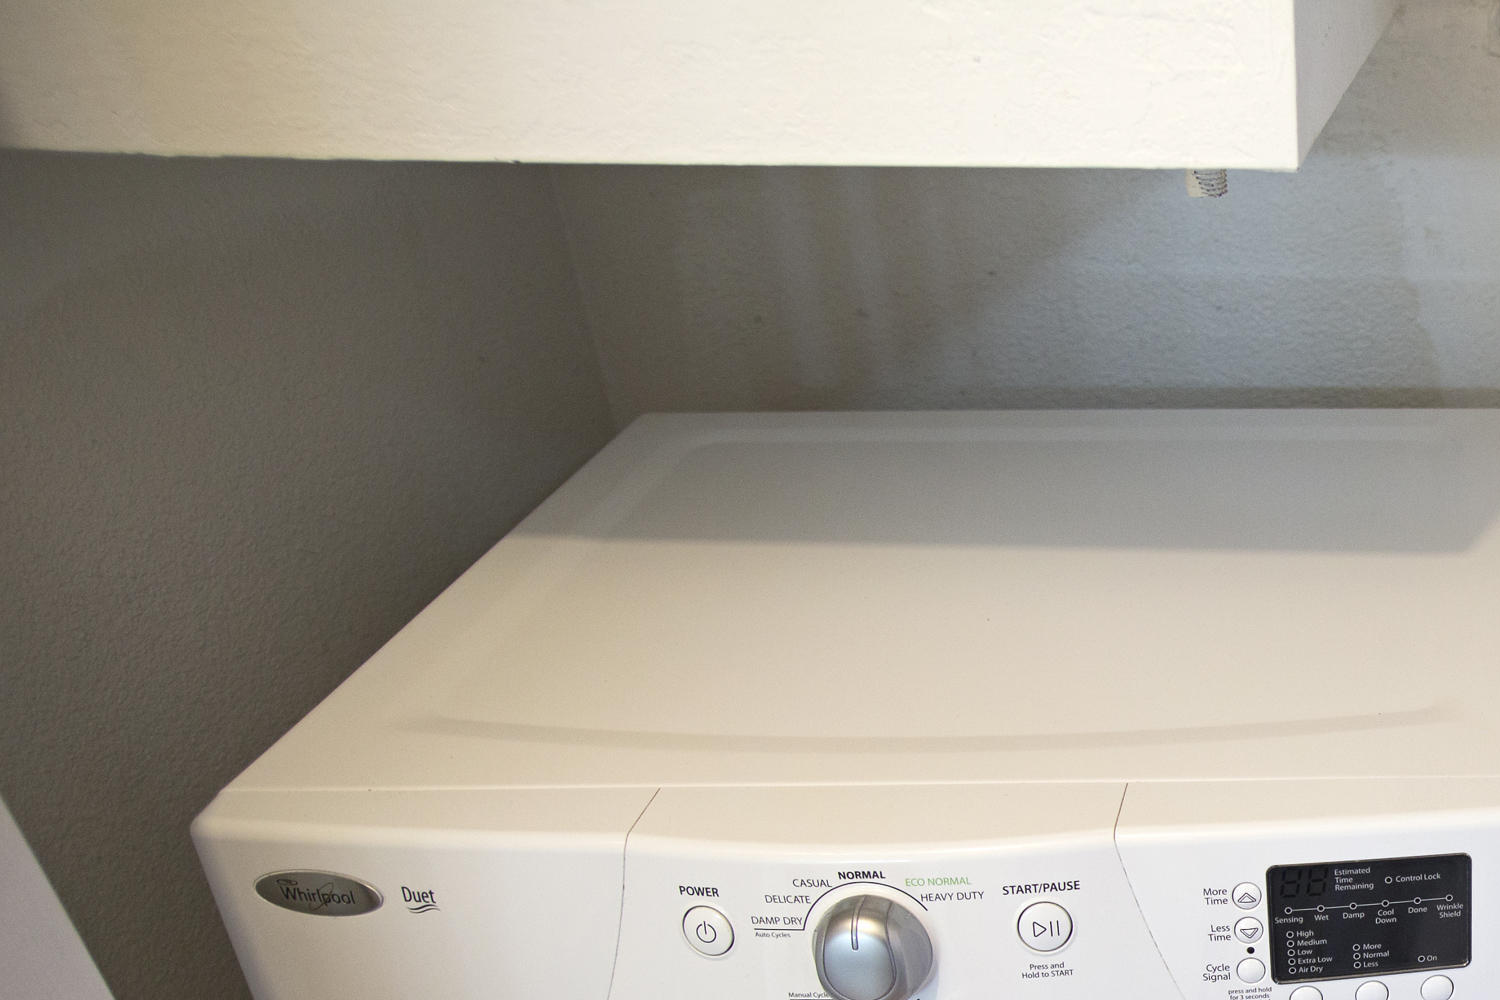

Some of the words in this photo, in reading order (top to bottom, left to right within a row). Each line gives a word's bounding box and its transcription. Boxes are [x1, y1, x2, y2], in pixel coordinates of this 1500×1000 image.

[838, 870, 886, 880] NORMAL
[1334, 867, 1371, 876] Estimated
[905, 878, 924, 887] ECO
[927, 876, 972, 886] NORMAL
[1395, 874, 1423, 882] Control
[792, 878, 833, 888] CASUAL
[1002, 880, 1080, 895] START/PAUSE
[1335, 883, 1375, 891] Remaining
[279, 886, 356, 906] Whirlpool
[401, 887, 436, 903] Duet
[679, 885, 719, 898] POWER
[1203, 888, 1228, 896] More
[764, 894, 811, 904] DELICATE
[920, 892, 954, 902] HEAVY
[956, 891, 984, 901] DUTY
[1205, 897, 1228, 905] Time
[1408, 906, 1428, 914] Done
[1436, 903, 1464, 911] Wrinkle
[1439, 910, 1461, 919] Shield
[751, 916, 781, 925] DAMP
[783, 917, 803, 926] DRY
[1274, 916, 1304, 924] Sensing
[1210, 924, 1231, 933] Less
[1208, 933, 1231, 942] Time
[1296, 930, 1314, 938] High
[1363, 950, 1389, 959] Normal
[1050, 961, 1065, 969] and
[1298, 957, 1316, 965] Extra
[1051, 969, 1074, 977] START
[1206, 964, 1230, 975] Cycle
[1310, 965, 1323, 973] Dry
[1202, 973, 1231, 983] Signal
